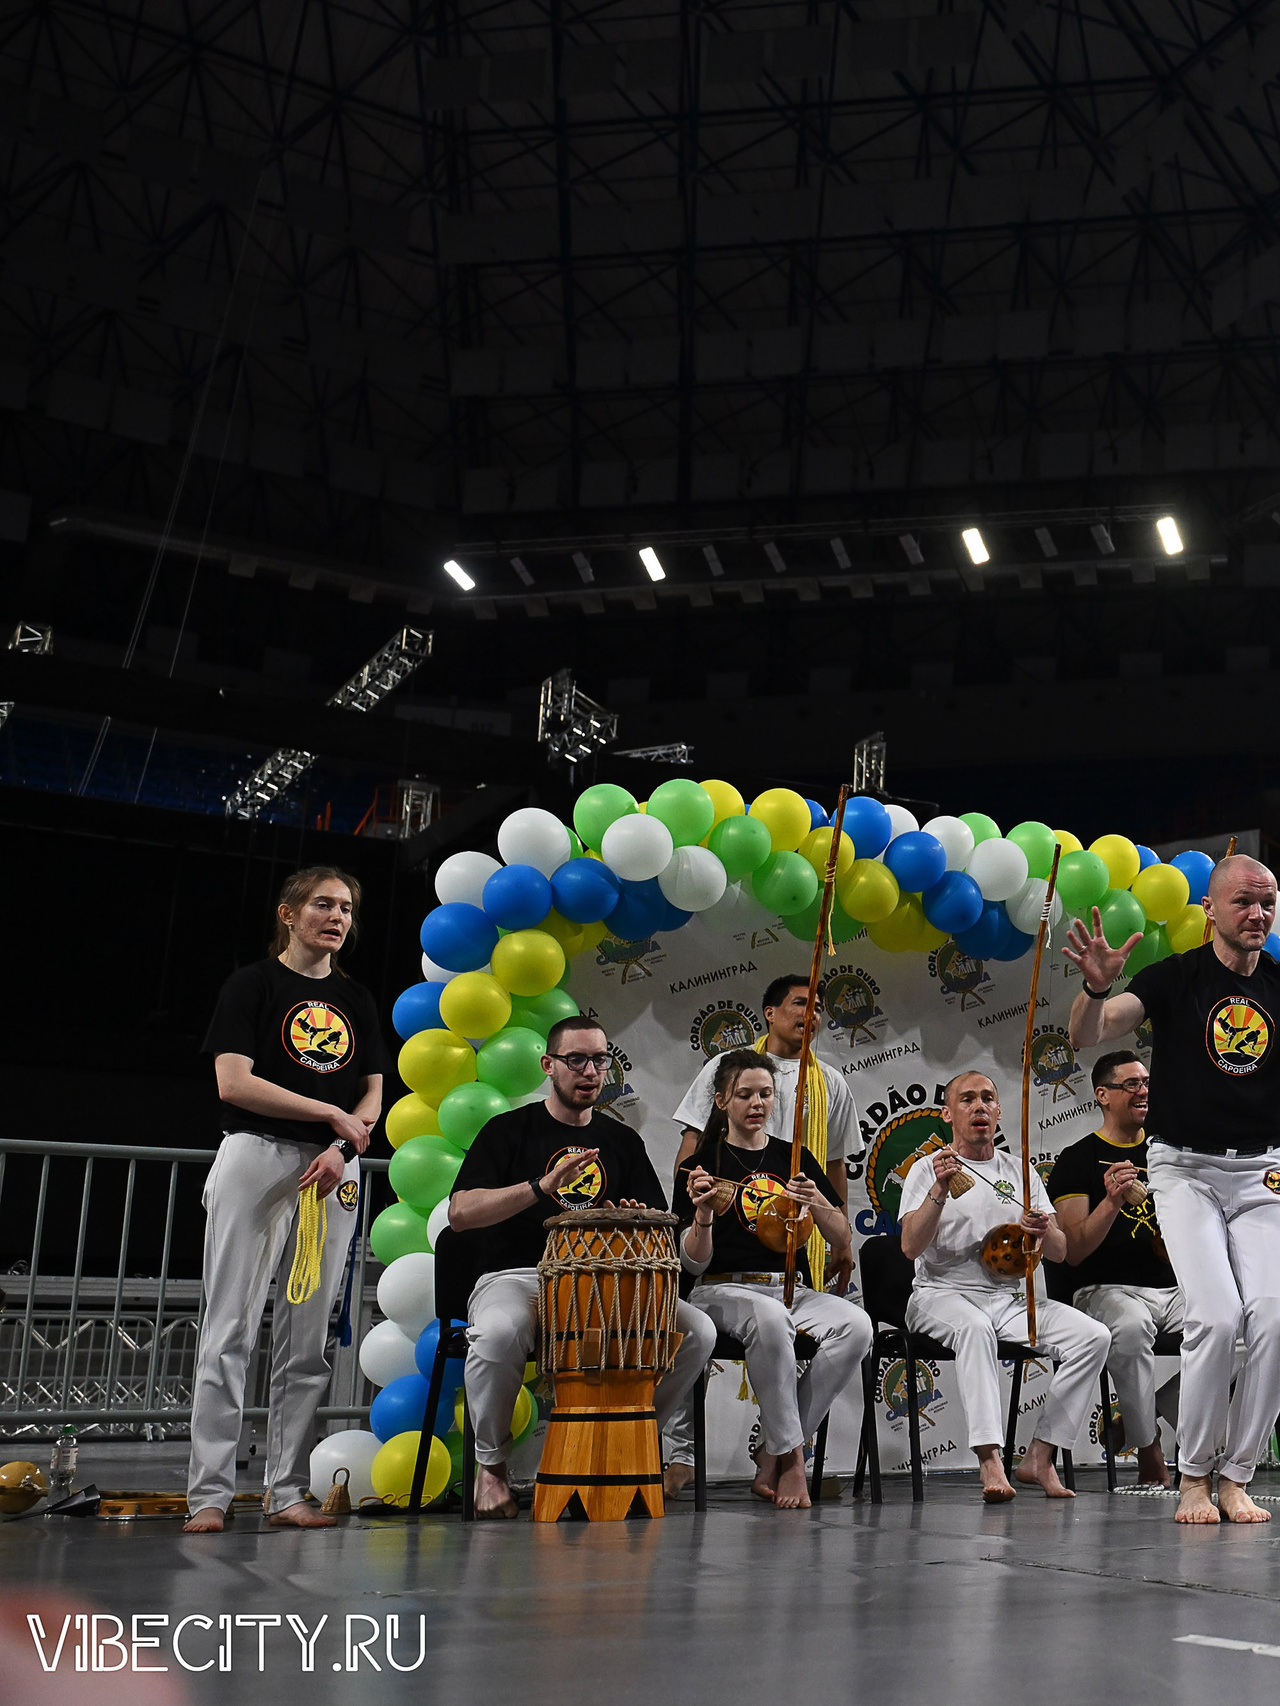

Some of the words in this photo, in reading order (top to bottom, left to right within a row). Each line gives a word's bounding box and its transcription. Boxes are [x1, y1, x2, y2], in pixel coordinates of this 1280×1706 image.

[669, 960, 758, 994] КАЛИНИНГРАД
[839, 964, 854, 974] DE
[855, 967, 881, 996] OURO
[308, 1001, 330, 1011] REAL
[977, 996, 1050, 1029] КАЛИНИНГАД
[1229, 997, 1251, 1007] REAL
[690, 1003, 716, 1051] CORDÃO
[717, 1000, 734, 1010] DE
[735, 1002, 763, 1032] OURO
[1041, 1024, 1055, 1034] DE
[300, 1056, 341, 1072] CAPOEIRA
[606, 1041, 633, 1072] OURO
[841, 1041, 921, 1076] КАЛИНИНГРАД
[1217, 1059, 1258, 1074] CAPOEIRA
[1037, 1098, 1102, 1131] КАЛИНИНГРА
[1038, 1152, 1052, 1162] DE
[751, 1173, 771, 1181] REAL
[560, 1198, 594, 1212] CAPOEIRA
[1088, 1403, 1103, 1445] CORDÃ
